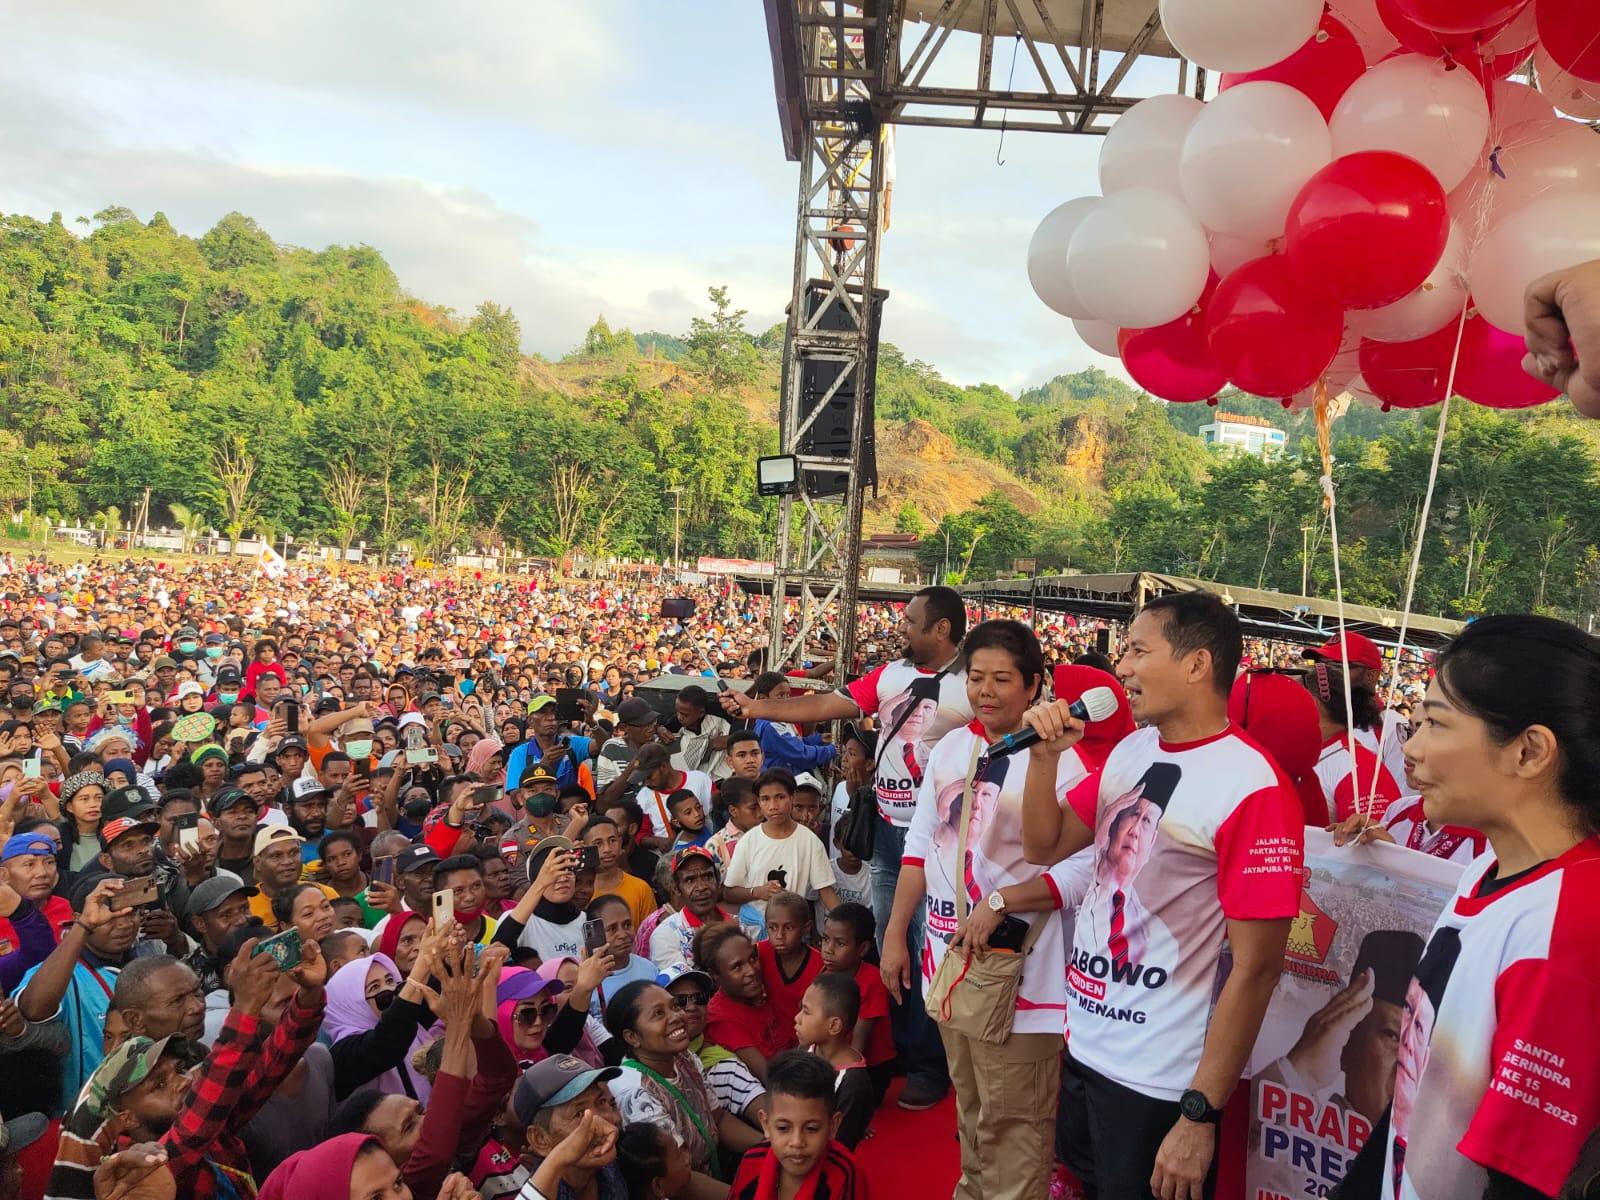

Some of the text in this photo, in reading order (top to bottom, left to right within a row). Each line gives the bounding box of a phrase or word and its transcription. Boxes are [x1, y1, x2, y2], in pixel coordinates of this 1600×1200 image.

[1249, 847, 1276, 855] PARTAI
[1255, 838, 1279, 846] JALAN
[1242, 865, 1283, 875] JAYAPURA
[1264, 856, 1280, 864] HUT
[1071, 947, 1168, 989] ABOWO
[1079, 995, 1146, 1024] MENANG
[1514, 1038, 1565, 1068] SANTAI
[1501, 1066, 1522, 1084] KE
[1525, 1077, 1541, 1091] 15
[1496, 1081, 1540, 1109] PAPUA
[1543, 1102, 1578, 1127] 2023
[1262, 1083, 1371, 1154] PRAB
